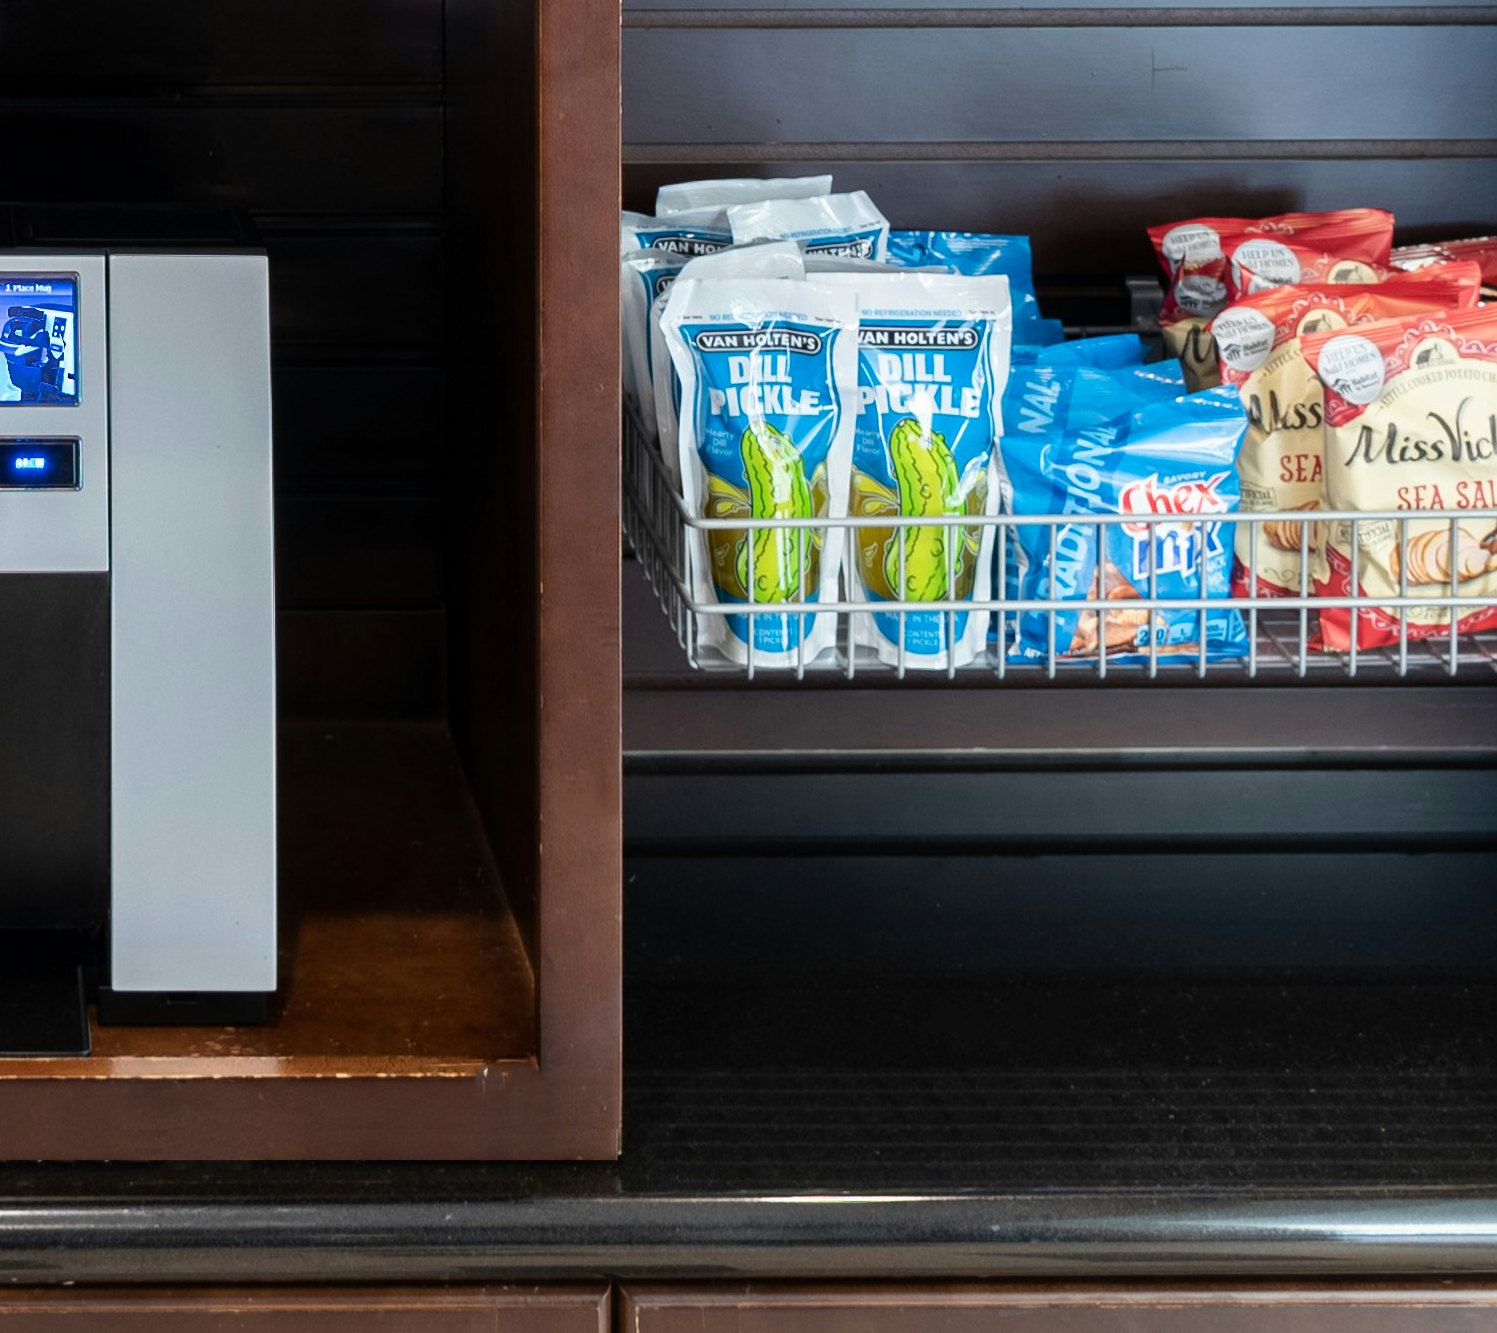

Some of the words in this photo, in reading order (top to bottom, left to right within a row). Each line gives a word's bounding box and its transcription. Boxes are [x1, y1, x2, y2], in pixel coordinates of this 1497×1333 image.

[13, 284, 34, 292] Place
[36, 284, 51, 293] Mug
[703, 336, 739, 347] VAN
[744, 336, 815, 351] HOLTEN'S
[858, 331, 890, 344] VAN
[894, 332, 973, 345] HOLTEN'S
[728, 355, 792, 384] DILL
[877, 353, 952, 383] DILL
[711, 387, 821, 416] PICKLE
[859, 386, 981, 418] PICKLE
[1345, 423, 1443, 466] Miss
[1163, 471, 1206, 485] SAVORY
[1397, 486, 1444, 510] SEA
